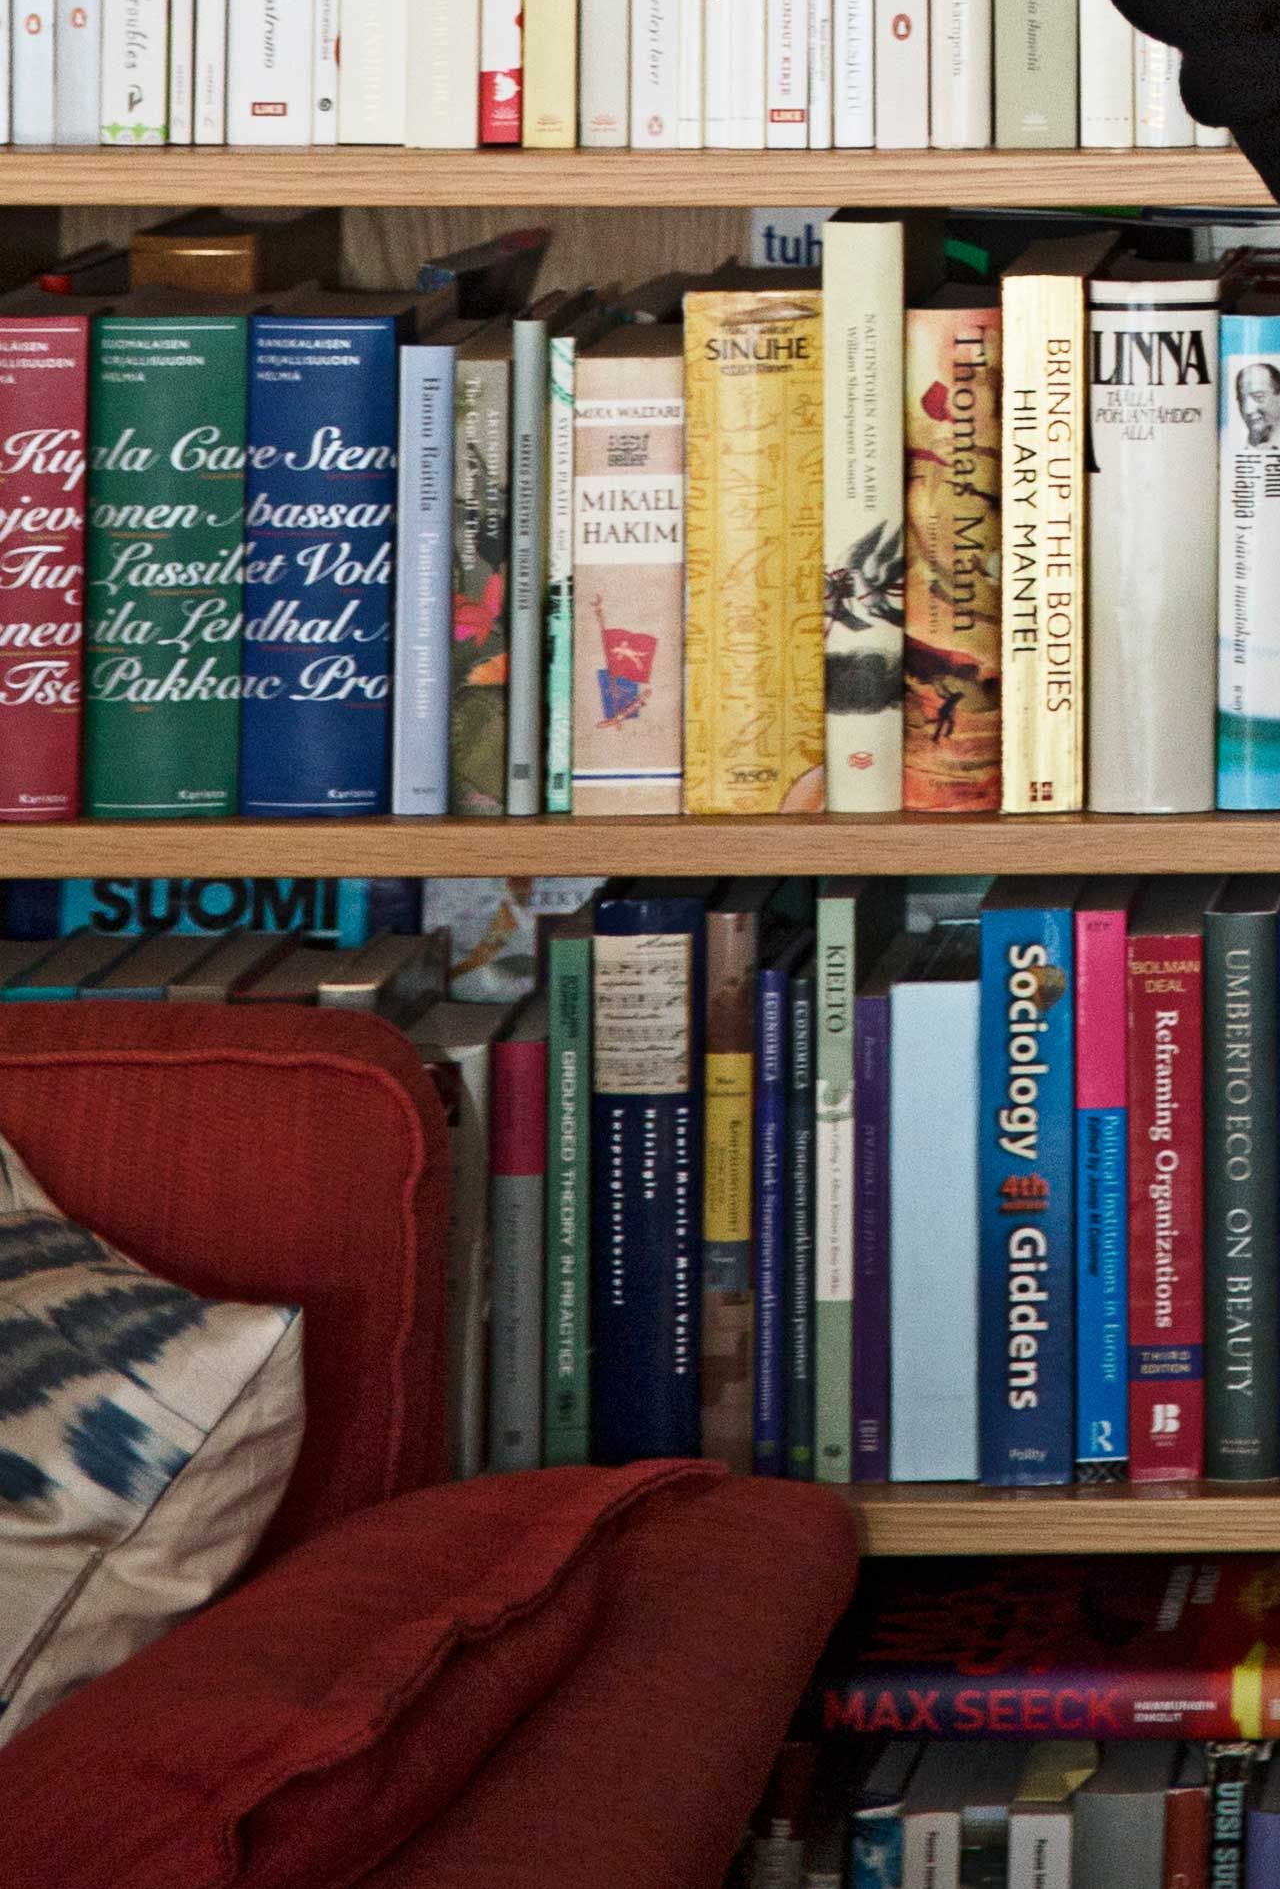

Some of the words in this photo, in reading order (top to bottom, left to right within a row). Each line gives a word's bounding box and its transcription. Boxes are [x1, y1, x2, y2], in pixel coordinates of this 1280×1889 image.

[1012, 390, 1036, 509] HILARY
[1045, 339, 1068, 443] BRING
[1046, 457, 1069, 502] UP
[1013, 524, 1036, 657] MANTEL
[1048, 513, 1069, 577] THE
[1046, 591, 1070, 712] BODIES
[999, 944, 1047, 1159] Sociology
[1226, 950, 1251, 1106] UMBERTO
[1226, 1116, 1251, 1180] ECO
[1227, 1208, 1252, 1258] ON
[1008, 1228, 1044, 1410] Giddens
[1227, 1276, 1253, 1396] BEAUTY
[825, 1692, 942, 1732] MAX
[950, 1688, 1122, 1731] SEECK
